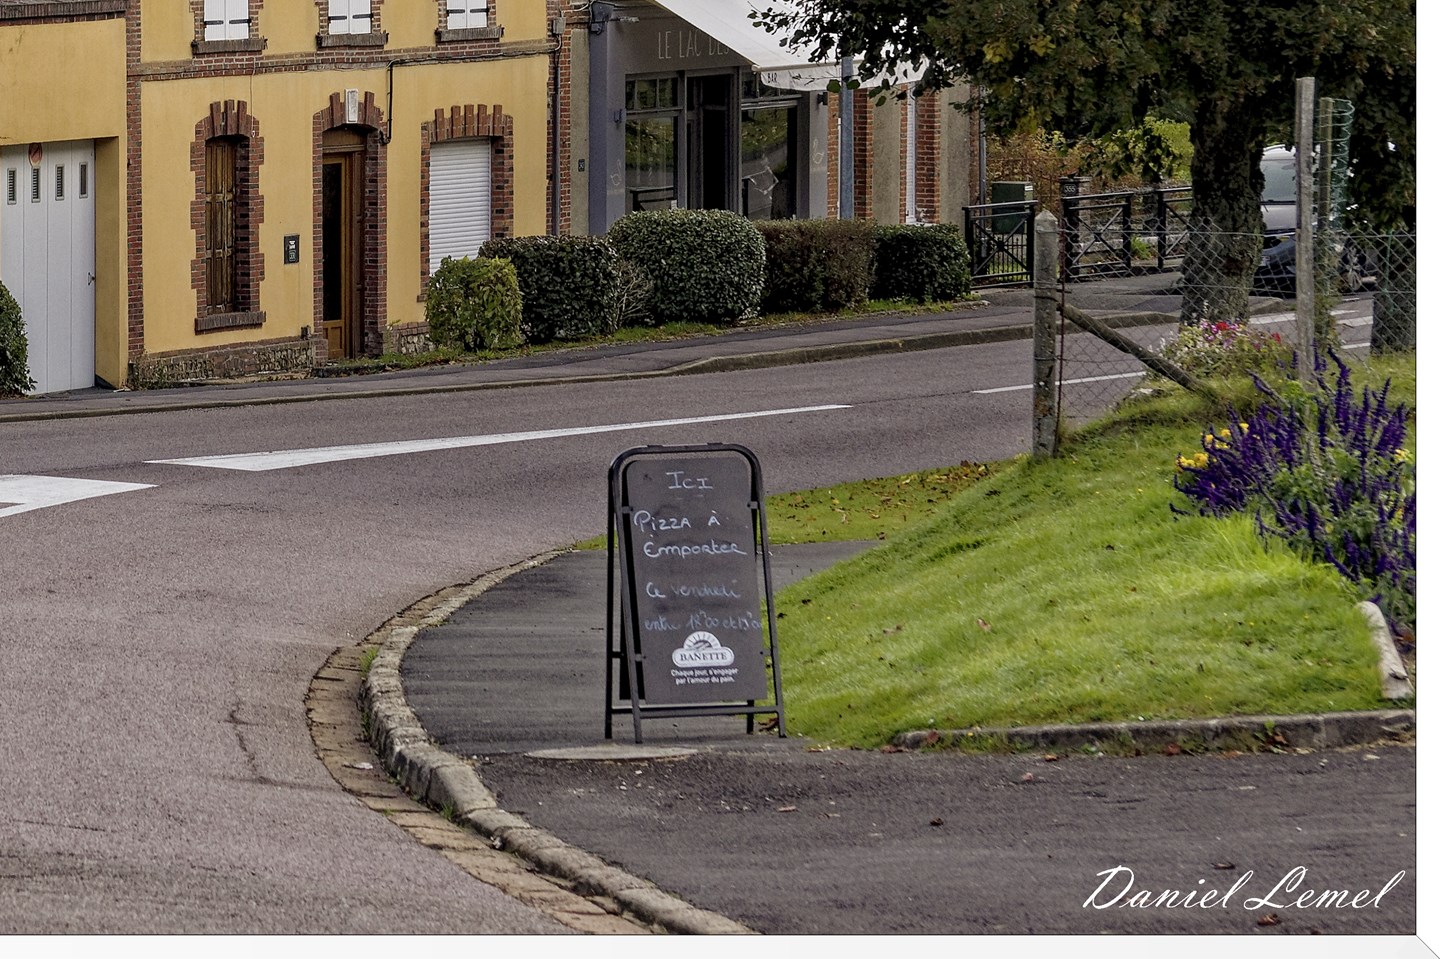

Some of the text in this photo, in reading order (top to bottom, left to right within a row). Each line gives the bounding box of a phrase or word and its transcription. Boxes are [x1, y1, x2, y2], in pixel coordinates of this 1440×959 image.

[658, 30, 672, 59] LE
[679, 29, 702, 58] LAC
[767, 72, 778, 84] BAR
[680, 652, 728, 661] BANETTE
